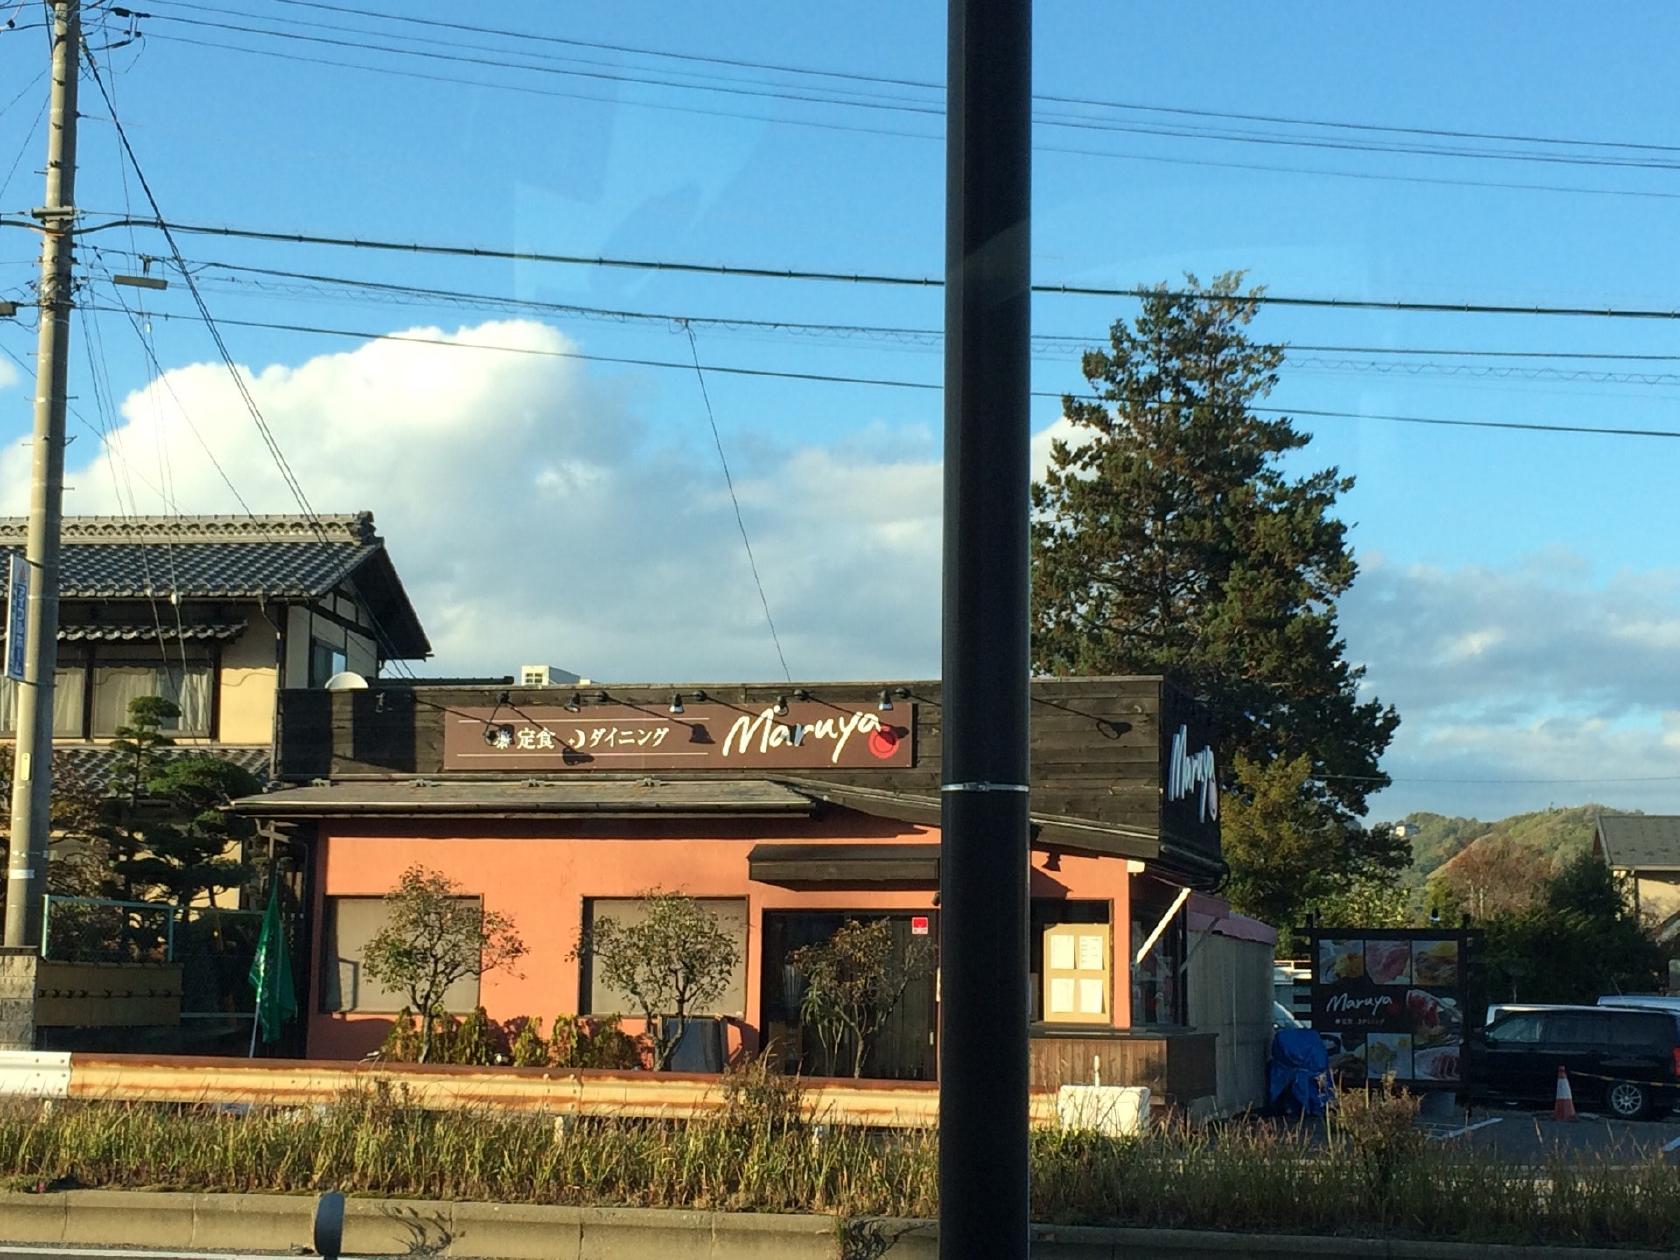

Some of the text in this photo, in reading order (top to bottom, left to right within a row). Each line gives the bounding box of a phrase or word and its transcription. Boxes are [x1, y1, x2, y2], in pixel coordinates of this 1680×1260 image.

[517, 727, 670, 749] 定食 ダイニング
[722, 708, 881, 763] Maruya
[1326, 992, 1393, 1016] Maruya
